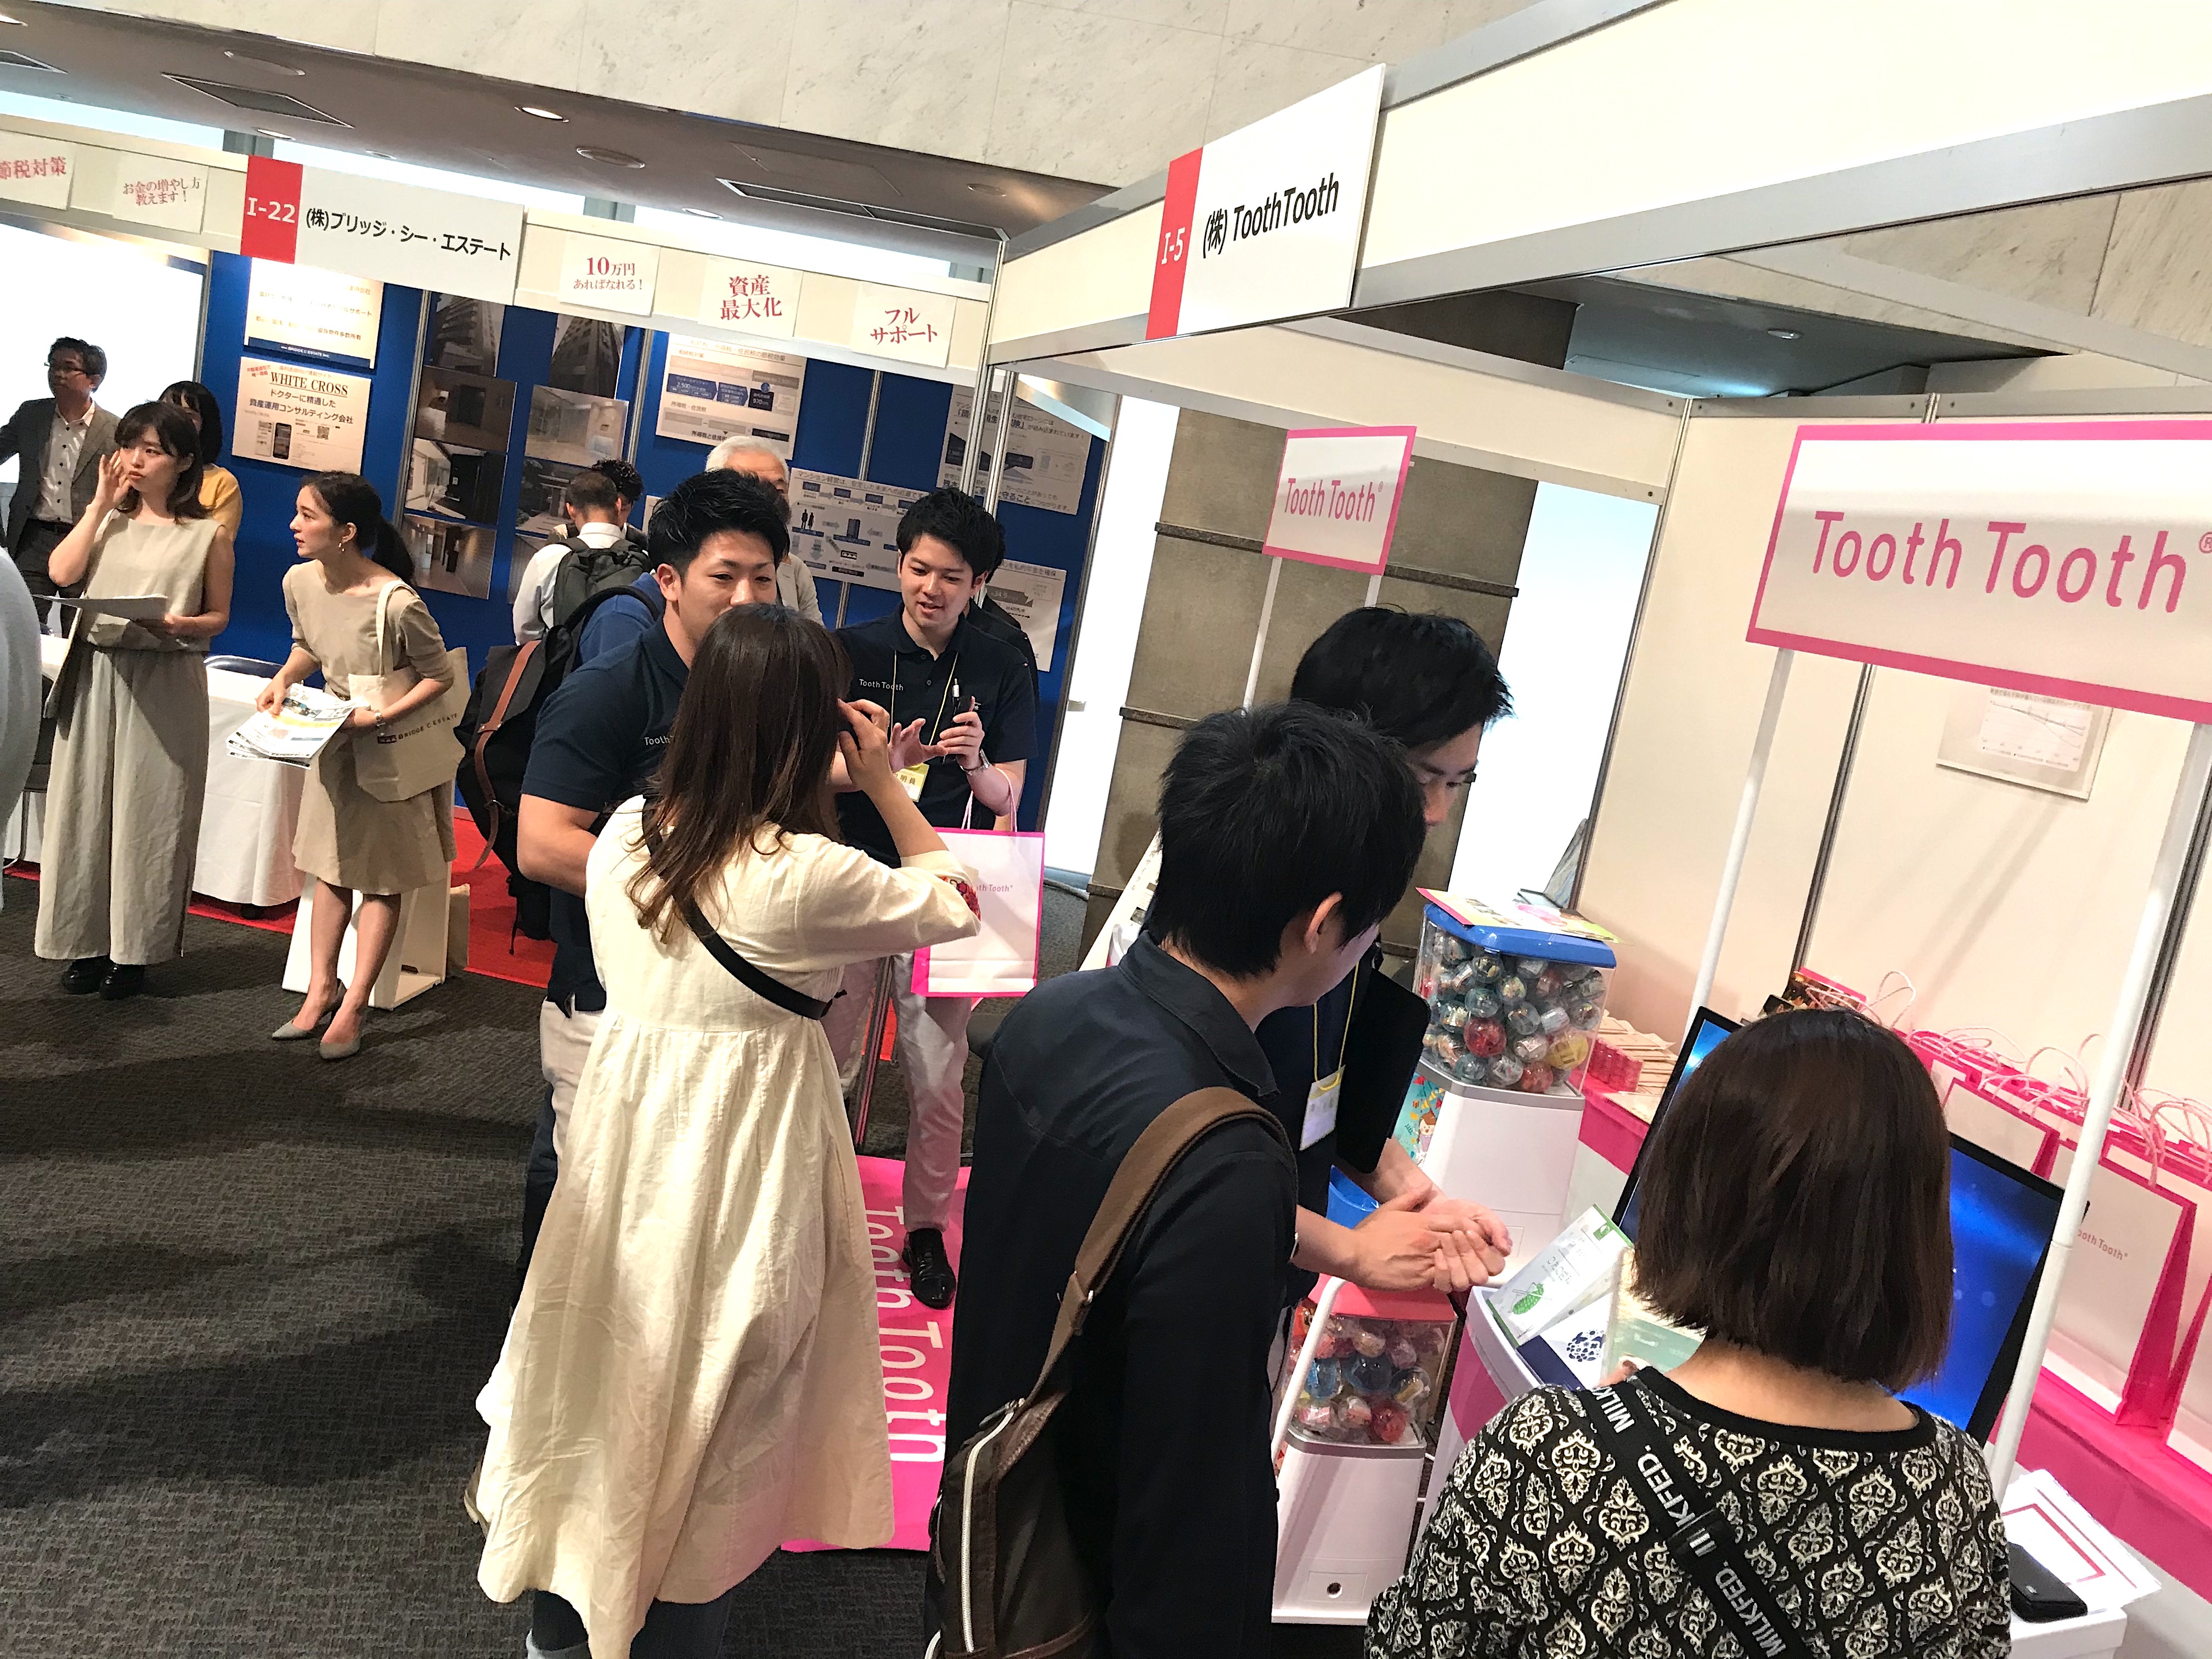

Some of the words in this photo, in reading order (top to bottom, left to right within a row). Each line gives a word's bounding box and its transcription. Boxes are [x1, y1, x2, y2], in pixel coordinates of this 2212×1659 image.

[123, 177, 201, 195] お金の増やし方
[247, 196, 296, 224] I-22
[1161, 227, 1186, 266] I-5
[585, 256, 636, 276] 10万円
[728, 274, 771, 297] 資産
[719, 298, 783, 321] 最大化
[884, 308, 919, 325] フル
[870, 324, 939, 346] サポート
[270, 371, 307, 389] WHITE
[311, 380, 348, 396] CROSS
[1284, 478, 1325, 517] Tooth
[1813, 510, 1963, 589] Tooth
[859, 678, 881, 688] Tooth
[881, 681, 904, 691] Tooth
[644, 735, 671, 746] Tooth
